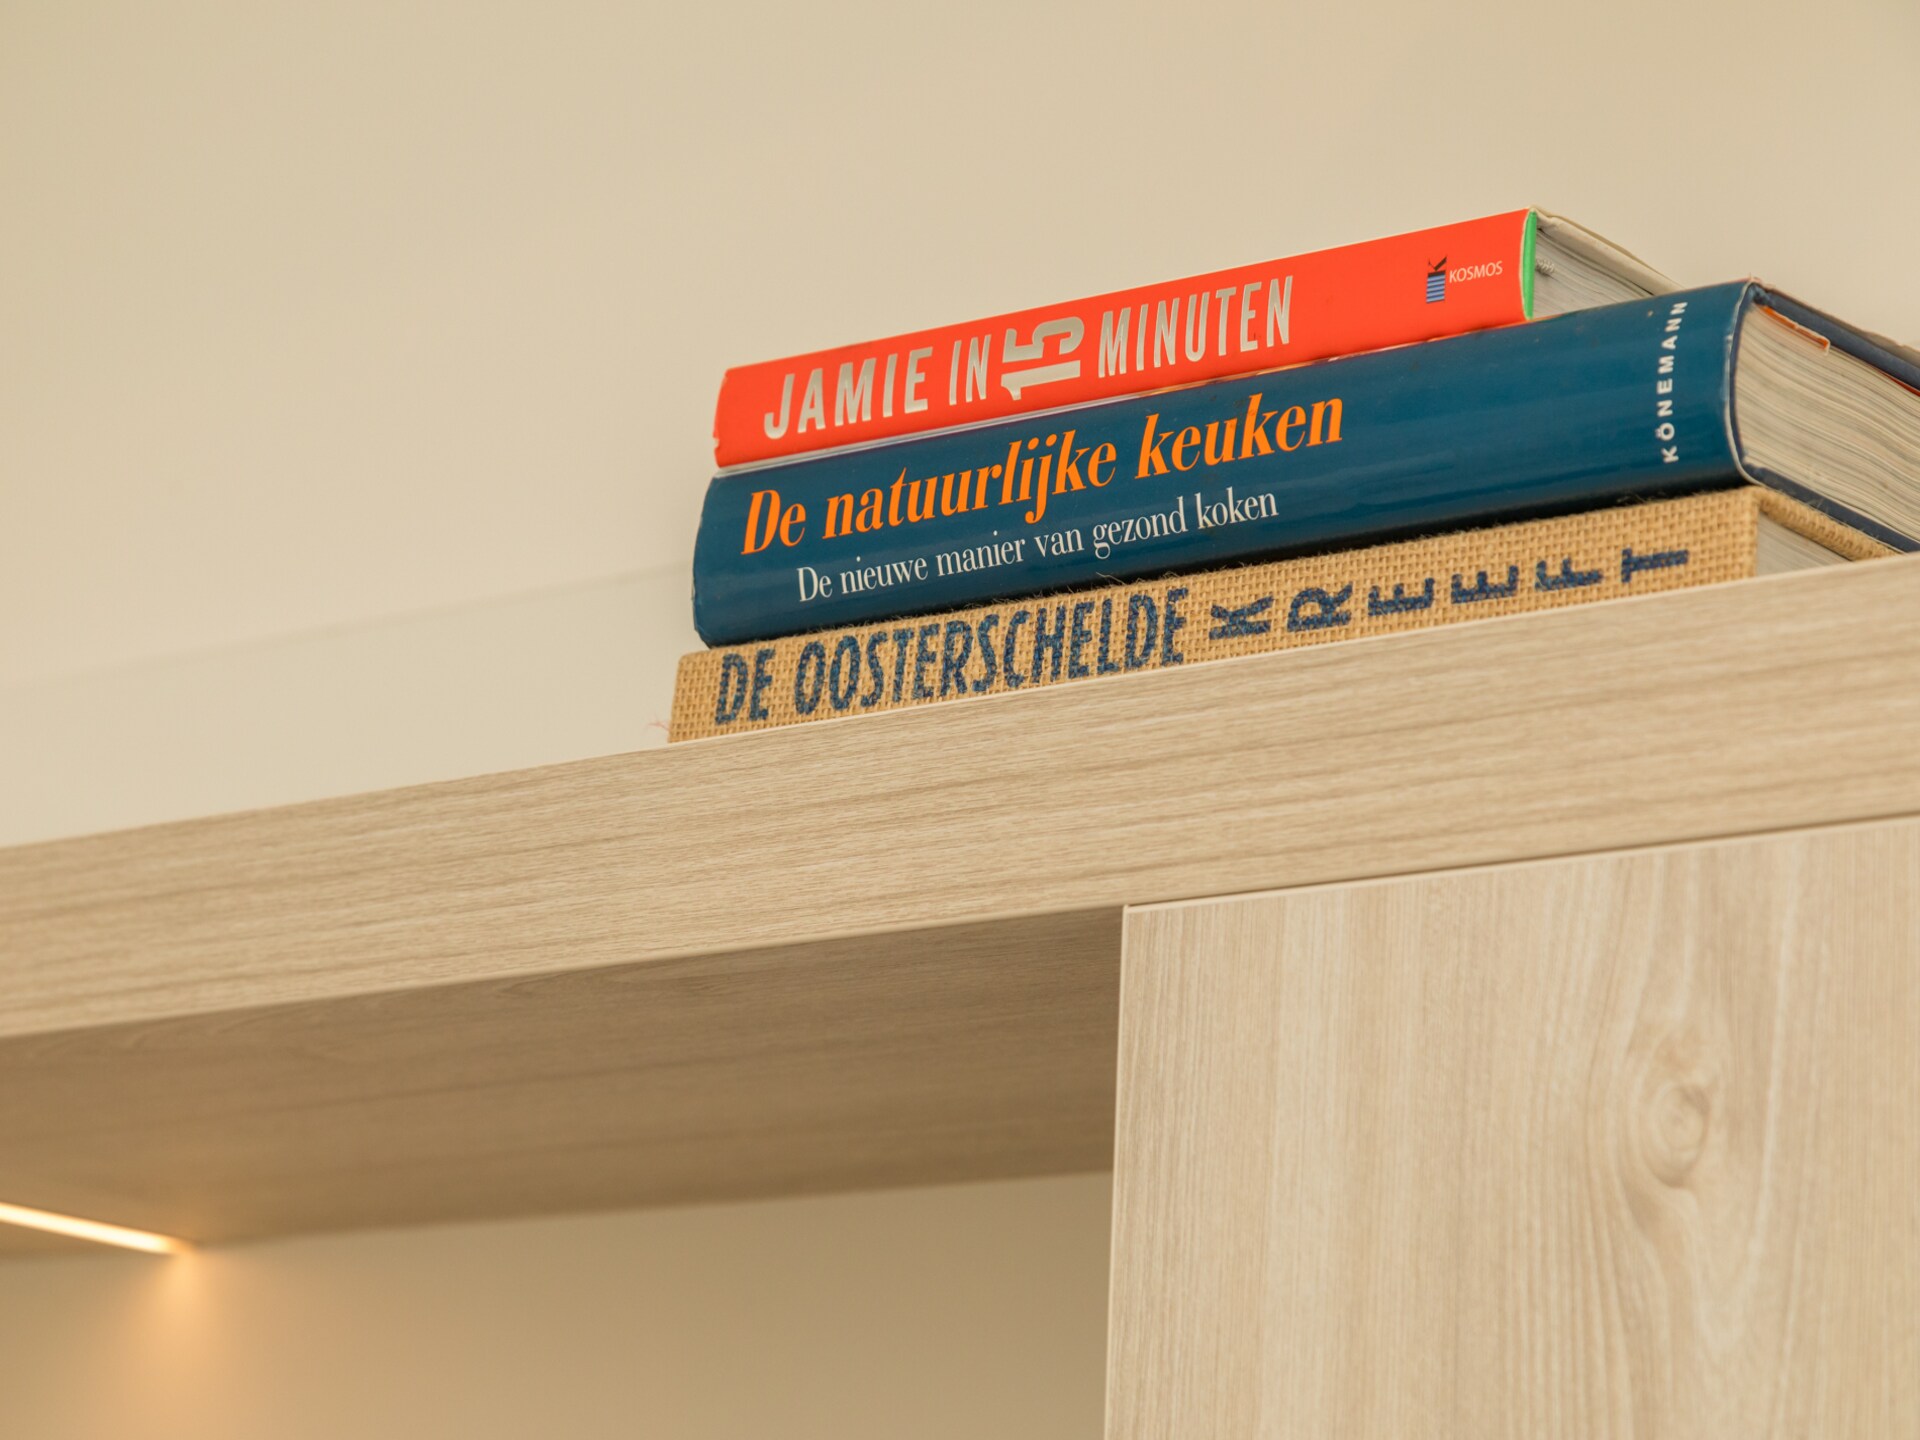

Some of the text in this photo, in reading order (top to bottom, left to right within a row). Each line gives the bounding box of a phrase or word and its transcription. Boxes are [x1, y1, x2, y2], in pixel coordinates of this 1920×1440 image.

[1448, 260, 1503, 284] KOSMOS
[764, 275, 1294, 440] JAMIE IN 15 MINUTEN
[1655, 301, 1689, 464] KÖNEMANN
[740, 392, 1344, 556] De natuurlijke keuken
[796, 485, 1280, 602] De nieuwe manier van gezond koken
[714, 547, 1690, 726] DE OOSTERSCHELDE KREEFT
